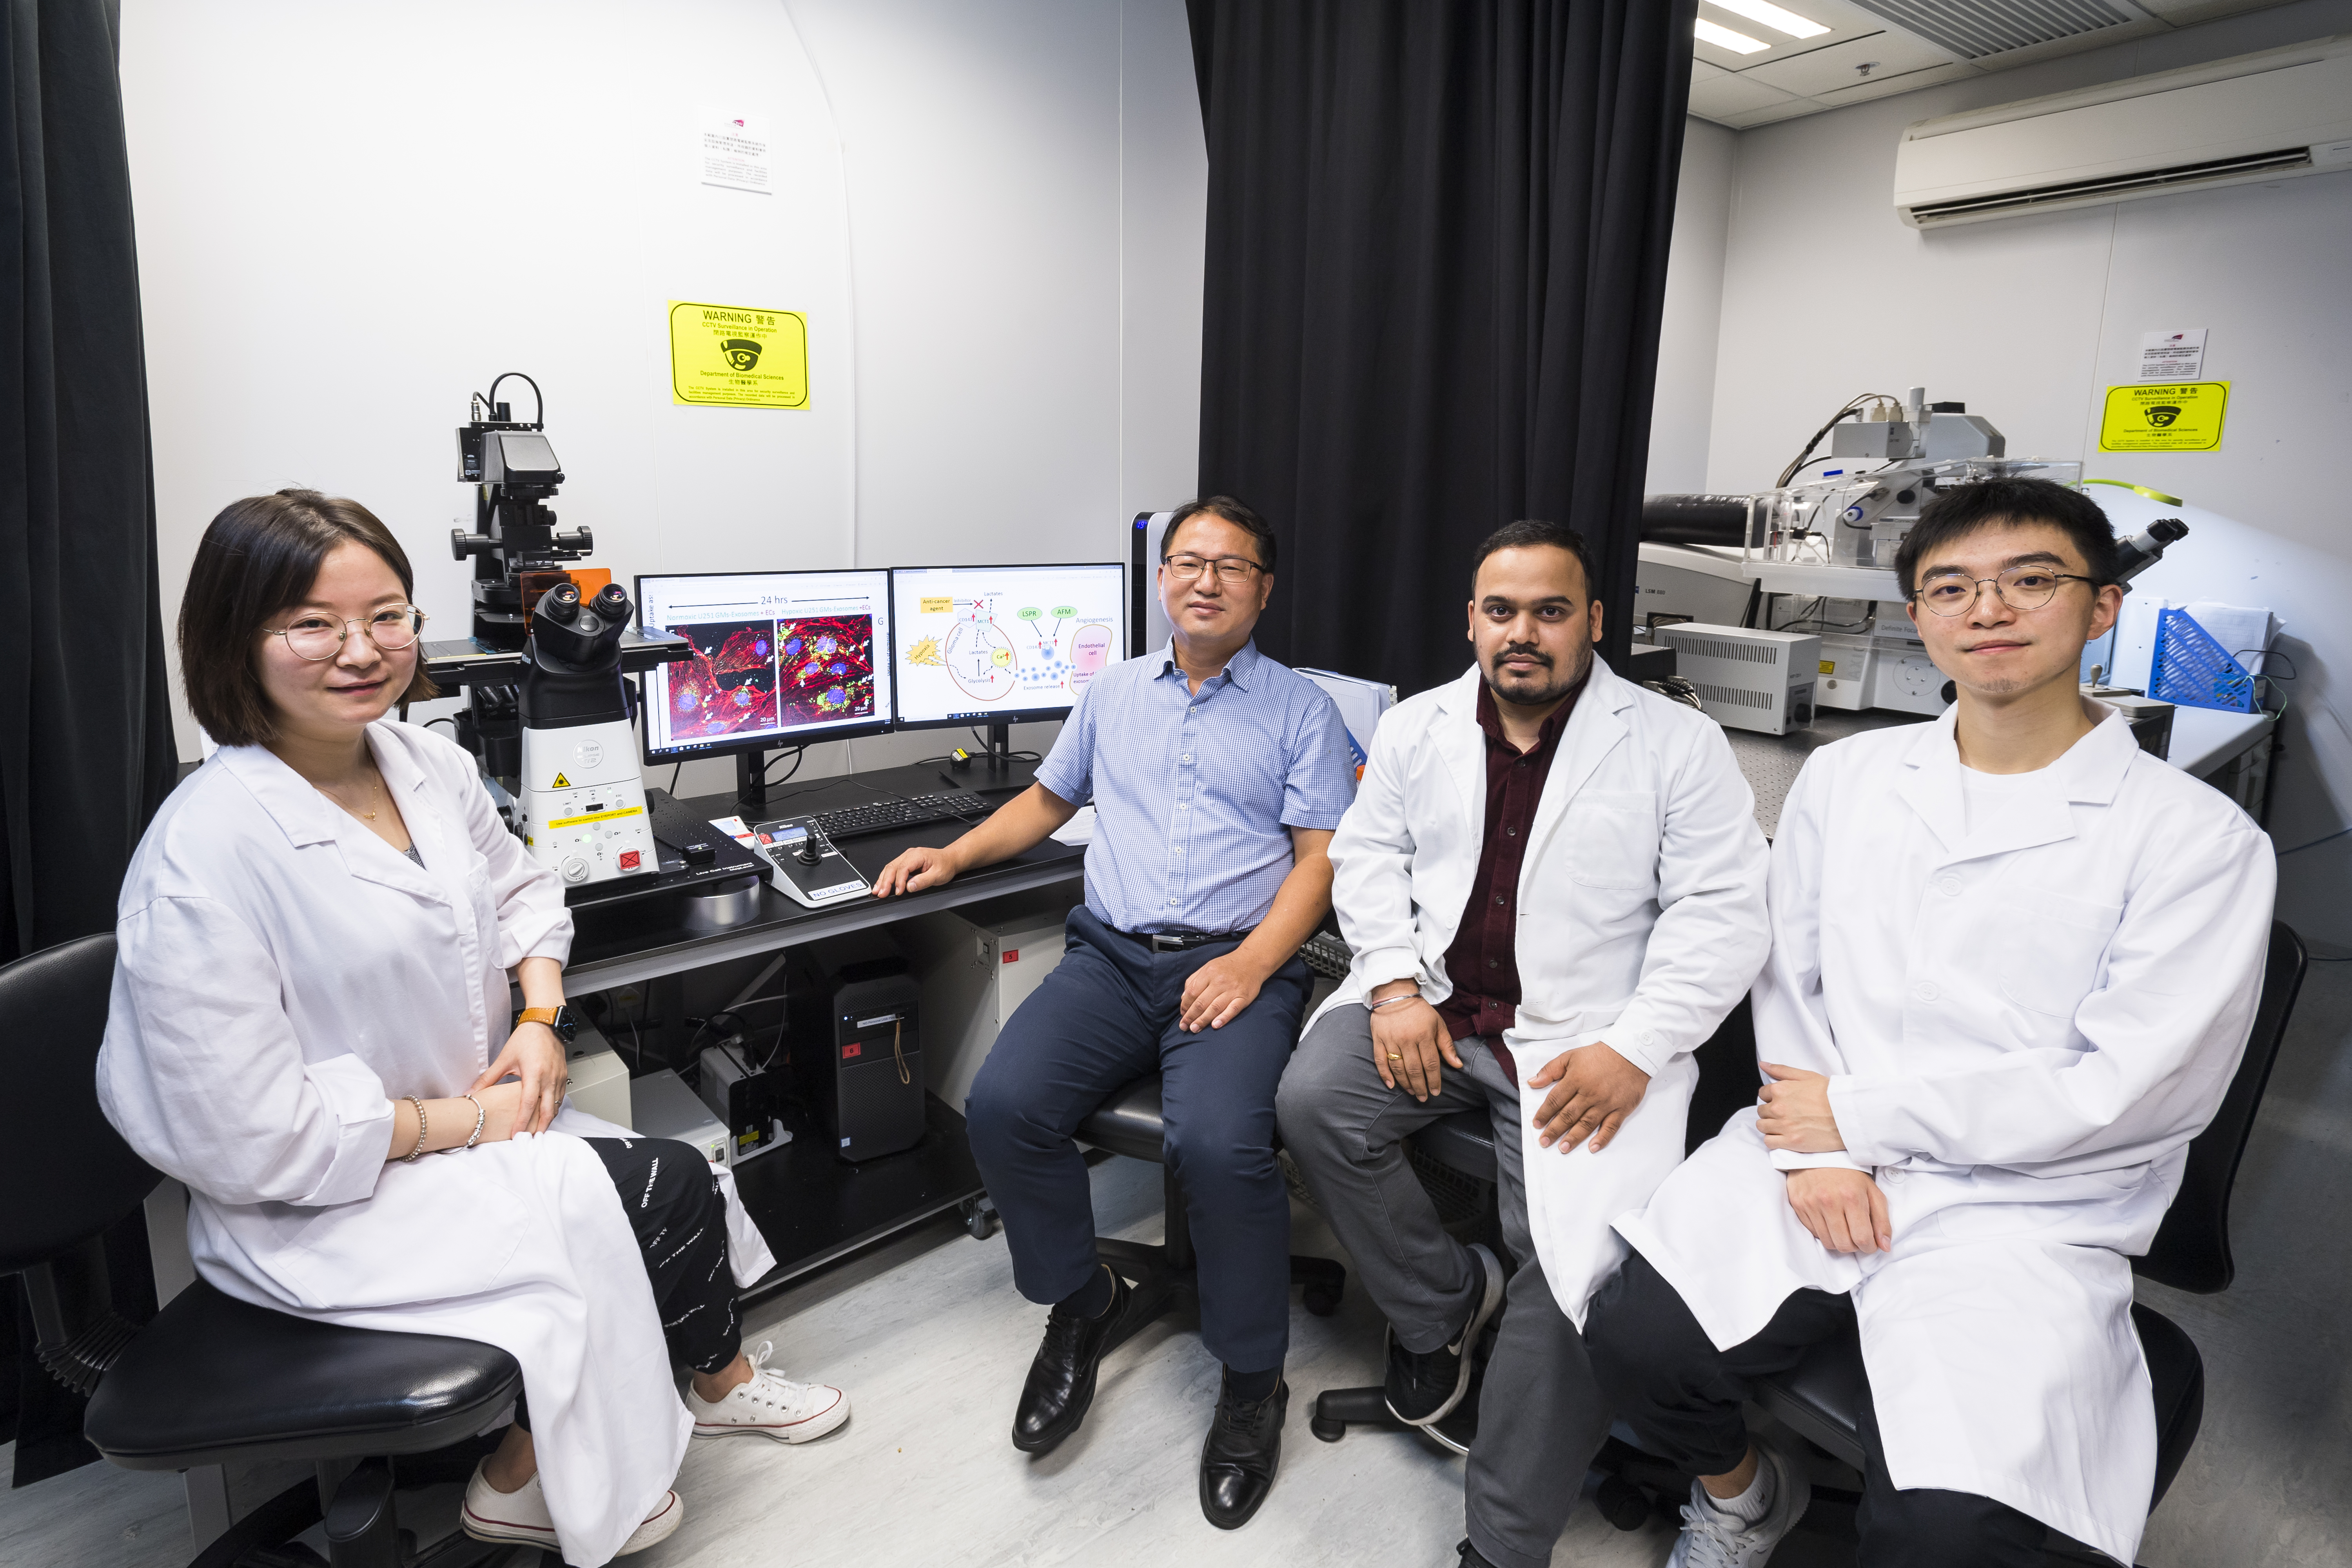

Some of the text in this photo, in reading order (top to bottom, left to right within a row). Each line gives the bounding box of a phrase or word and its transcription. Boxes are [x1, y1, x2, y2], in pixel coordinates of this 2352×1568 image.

[703, 310, 775, 325] WARNING 警告
[761, 595, 788, 605] 24 hrs
[914, 644, 930, 660] Hypoxia
[947, 637, 959, 654] Glioma
[828, 882, 862, 893] GLOVES
[641, 1158, 659, 1208] OFF THE WALL
[686, 1228, 704, 1245] WALL
